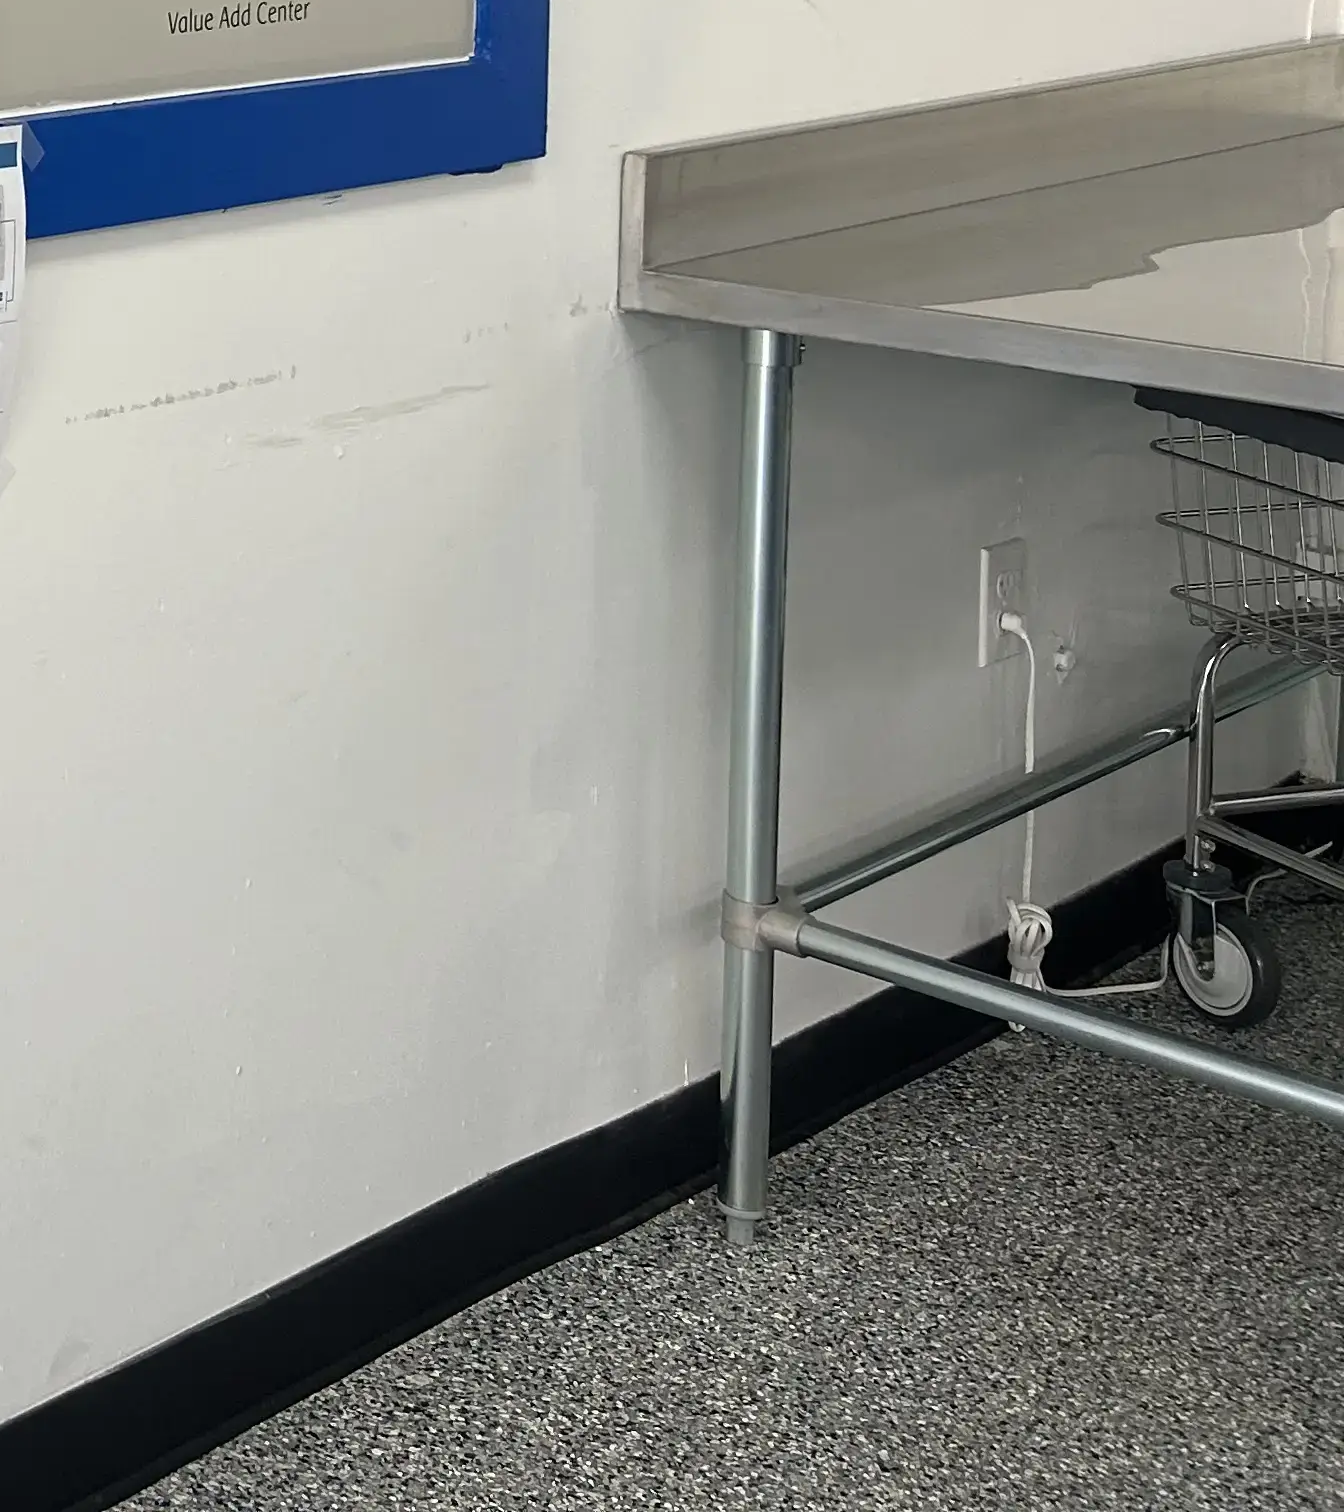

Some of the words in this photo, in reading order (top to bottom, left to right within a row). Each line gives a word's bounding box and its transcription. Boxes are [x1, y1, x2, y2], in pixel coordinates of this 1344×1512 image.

[168, 6, 214, 35] Value
[219, 3, 251, 29] Add
[257, 0, 310, 25] Center
